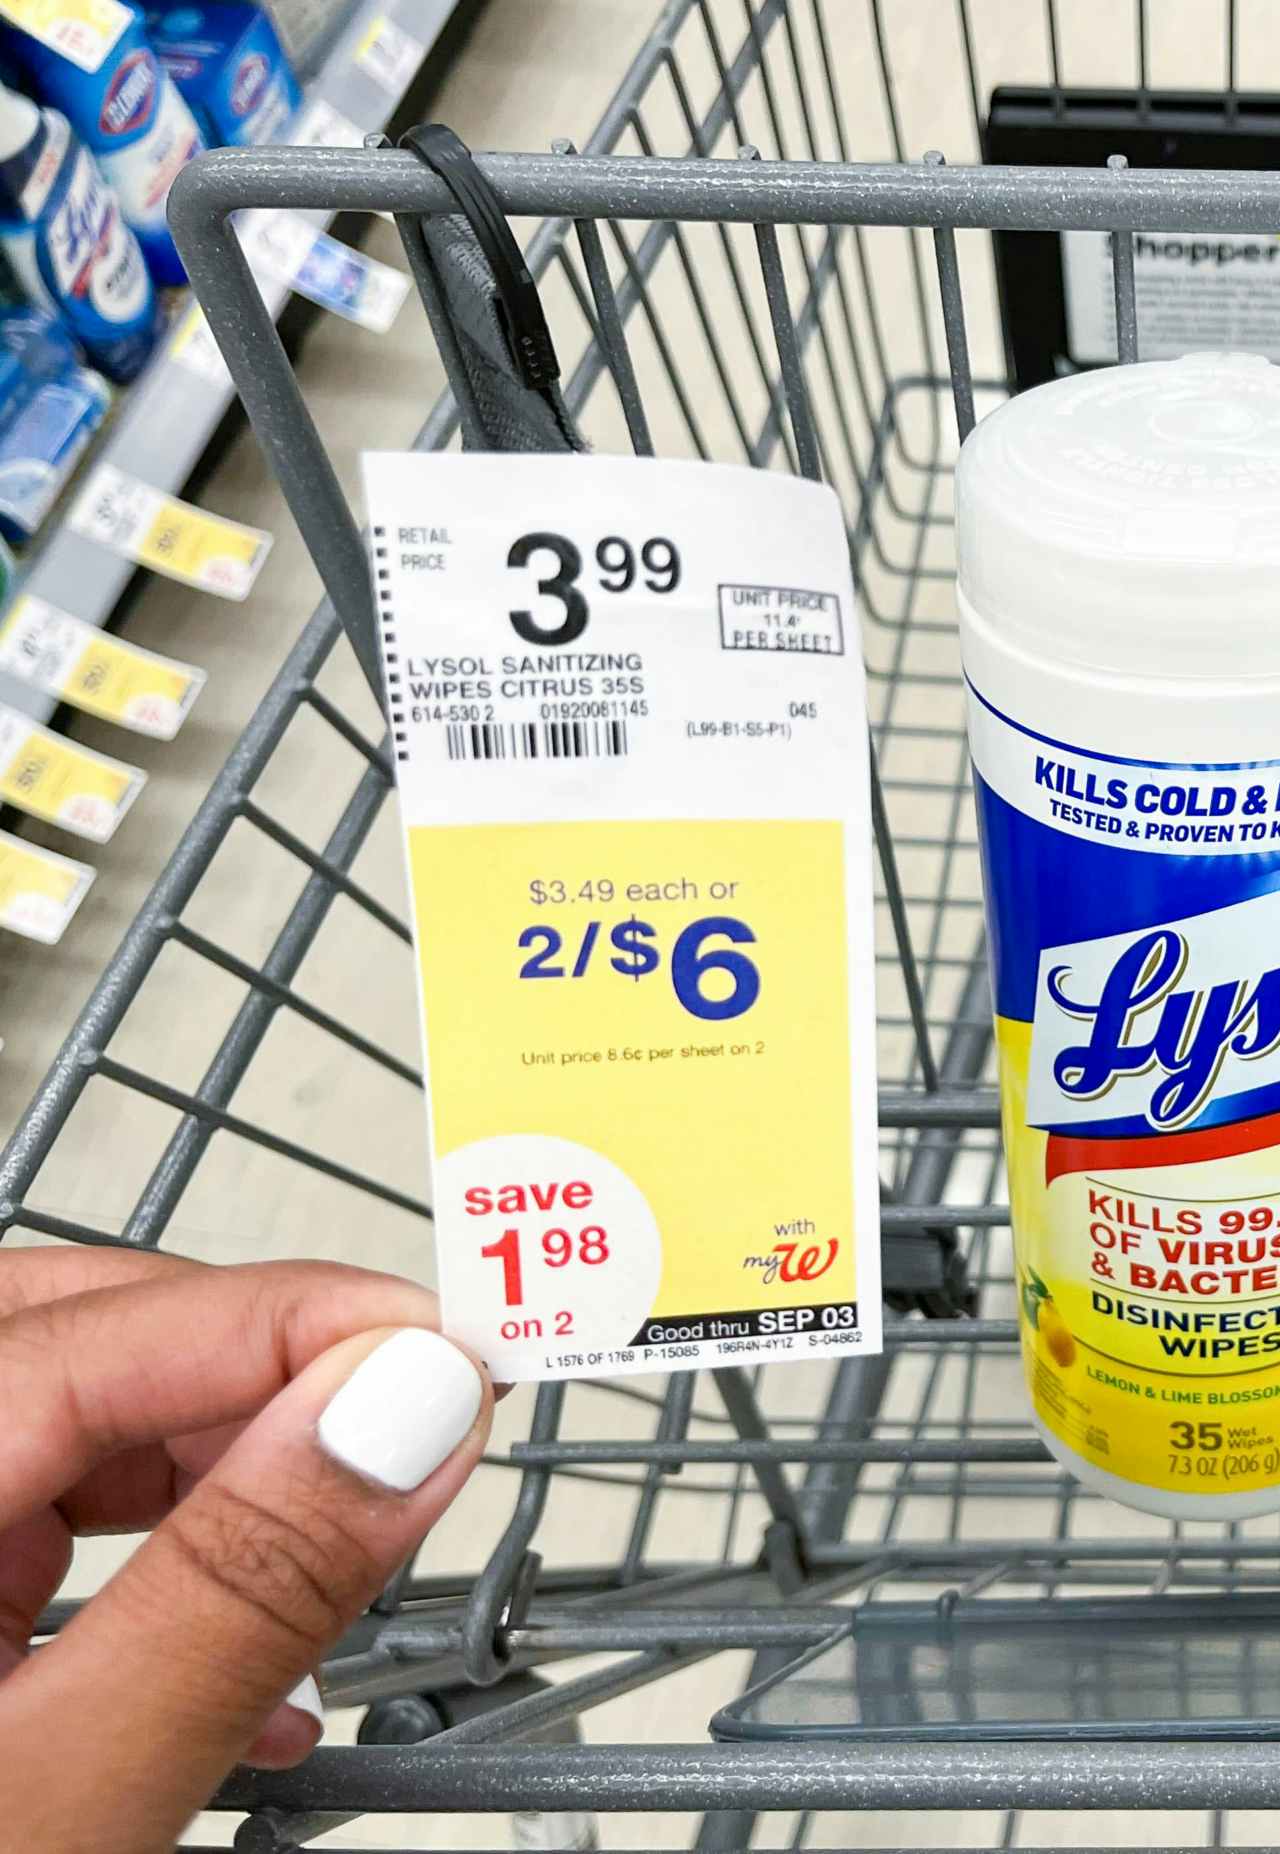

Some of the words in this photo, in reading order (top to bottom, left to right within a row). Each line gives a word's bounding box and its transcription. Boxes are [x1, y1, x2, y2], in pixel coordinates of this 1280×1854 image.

[398, 528, 451, 544] RETAIL
[401, 554, 446, 571] PRICE
[733, 590, 770, 606] UNIT
[778, 591, 828, 612] PRICE
[734, 630, 768, 649] PER
[776, 632, 832, 654] SHEET
[408, 657, 493, 677] LYSOL
[502, 653, 642, 675] SANITIZING
[410, 681, 493, 700] WIPES
[501, 678, 594, 698] CITRUS
[601, 676, 645, 695] 35S
[412, 704, 480, 722] 614-530
[485, 704, 495, 721] 2
[789, 702, 817, 719] 045
[1035, 756, 1128, 809] KILLS
[1135, 785, 1236, 818] COLD
[1242, 784, 1268, 816] &
[1049, 798, 1122, 835] TESTED
[1125, 820, 1141, 838] &
[1145, 821, 1234, 844] PROVEN
[1239, 821, 1266, 842] TO
[529, 879, 615, 905] $3.49
[626, 877, 698, 902] each
[709, 881, 740, 900] or
[521, 1051, 556, 1066] Unit
[561, 1049, 602, 1066] price
[649, 1048, 675, 1062] per
[681, 1043, 725, 1059] sheet
[730, 1043, 751, 1057] on
[755, 1041, 766, 1055] 2
[464, 1180, 594, 1216] save
[1088, 1188, 1202, 1235] KILLS
[774, 1218, 815, 1236] with
[1089, 1221, 1142, 1255] OF
[1091, 1251, 1116, 1280] &
[500, 1318, 543, 1341] on
[554, 1311, 575, 1336] 2
[647, 1322, 704, 1343] Good
[709, 1319, 750, 1338] thru
[758, 1309, 815, 1333] SEP
[821, 1306, 855, 1329] 03
[546, 1357, 553, 1369] L
[558, 1355, 584, 1367] 1576
[588, 1352, 604, 1365] OF
[644, 1344, 700, 1360] P-15085
[1086, 1364, 1141, 1394] LEMON
[1145, 1386, 1156, 1399] &
[1160, 1390, 1202, 1405] LIME
[1168, 1420, 1223, 1451] 35
[1227, 1426, 1257, 1439] Wet
[1227, 1435, 1274, 1450] Wipes
[1168, 1454, 1192, 1474] 7.3
[1196, 1456, 1218, 1477] OZ
[1222, 1453, 1261, 1480] (206
[1263, 1447, 1280, 1475] g)
